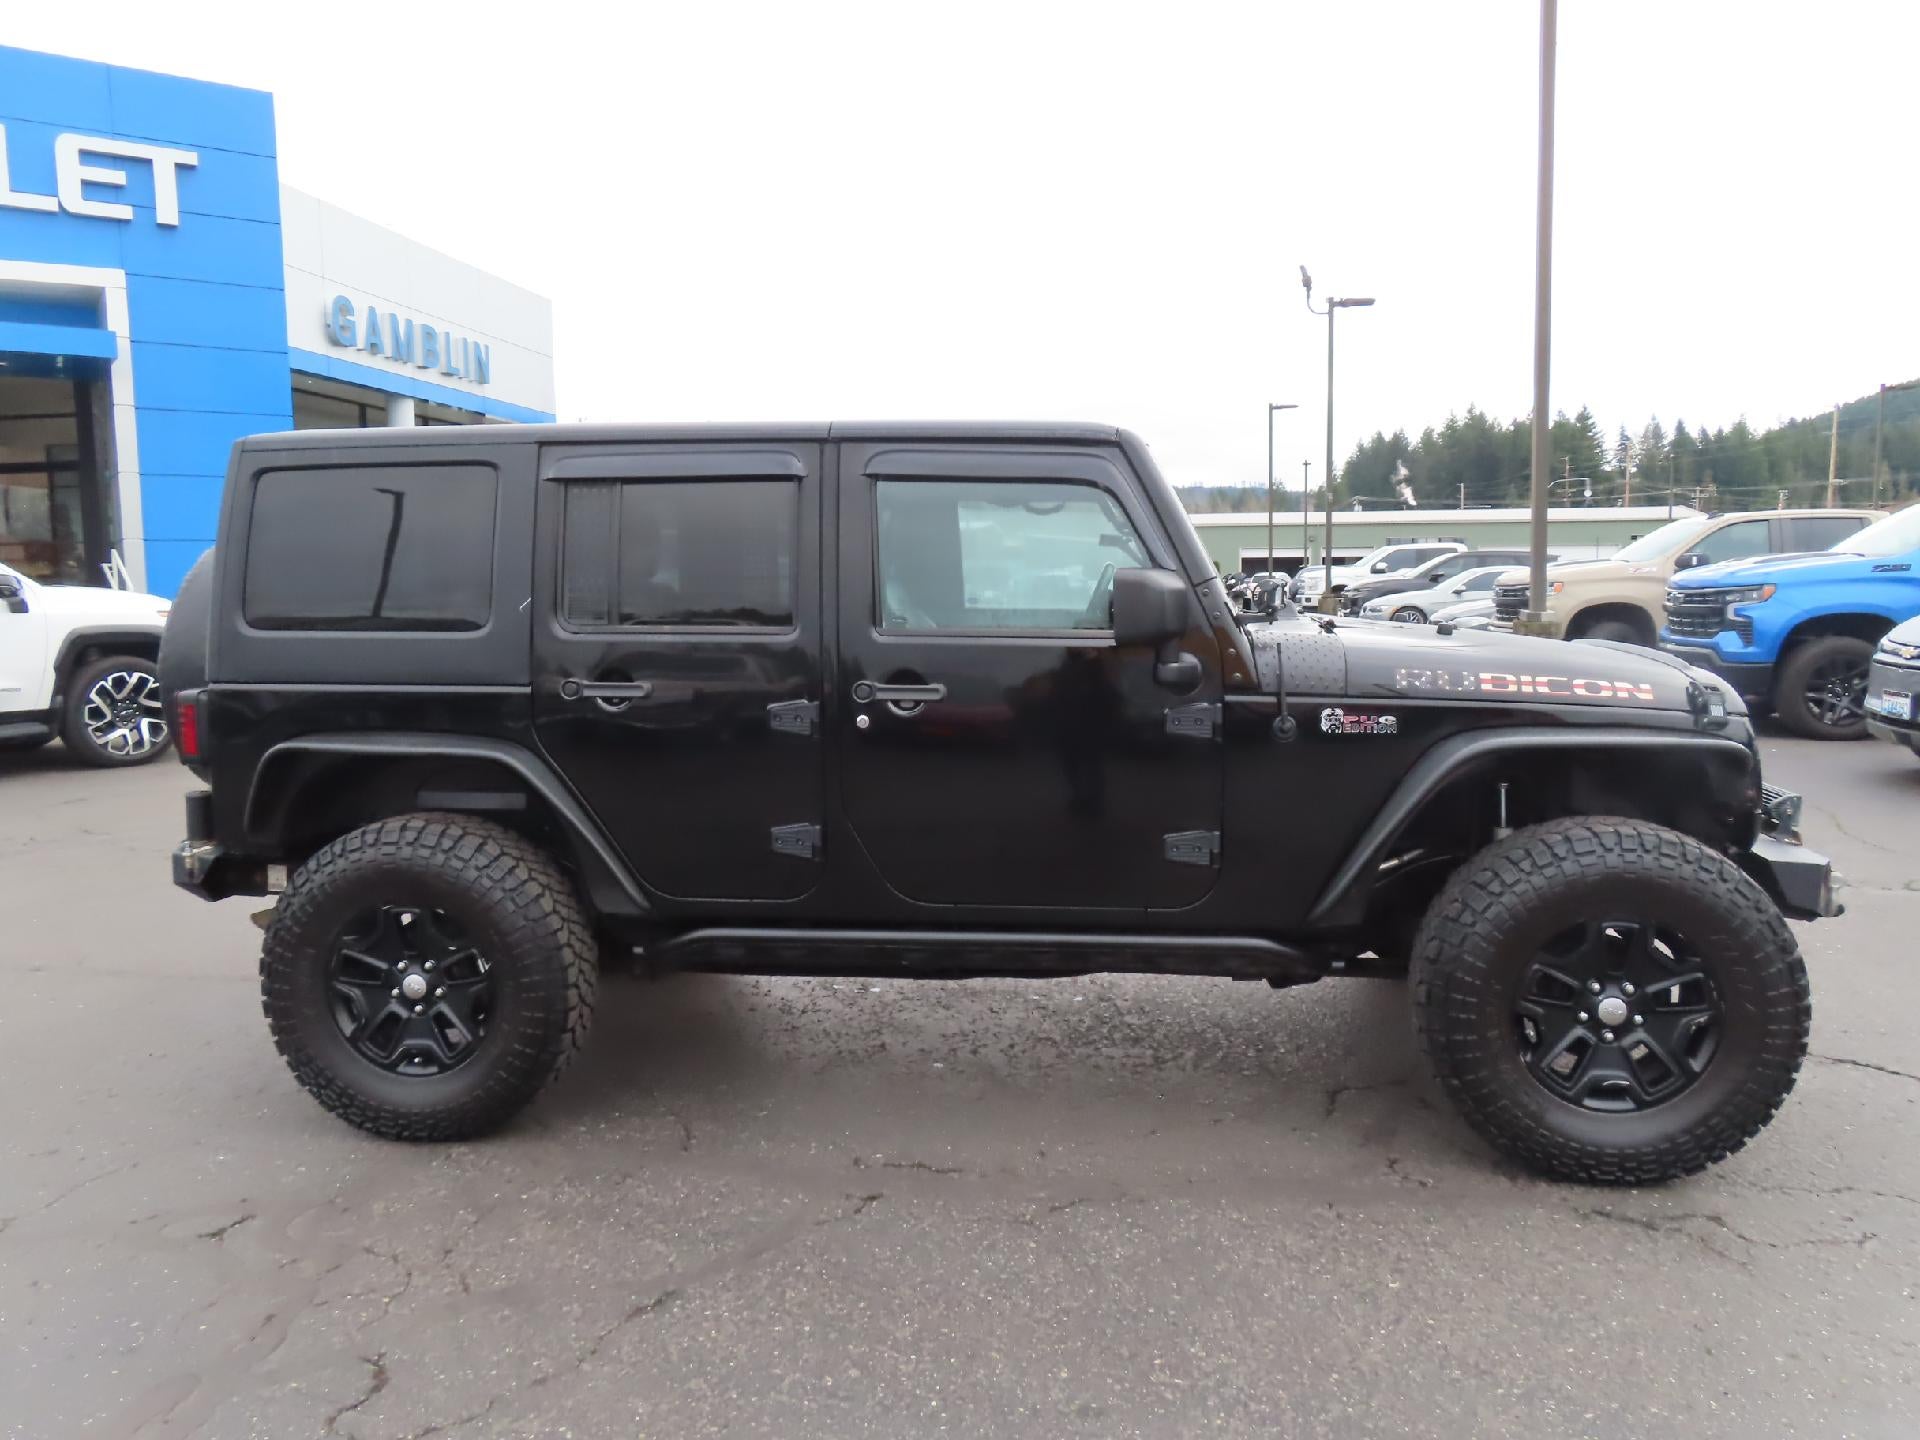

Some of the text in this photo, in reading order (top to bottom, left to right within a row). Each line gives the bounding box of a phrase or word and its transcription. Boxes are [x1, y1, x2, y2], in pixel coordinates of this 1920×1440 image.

[326, 294, 490, 384] GAMBLIN
[1396, 668, 1655, 701] RUBICON
[1343, 723, 1397, 733] EDITION
